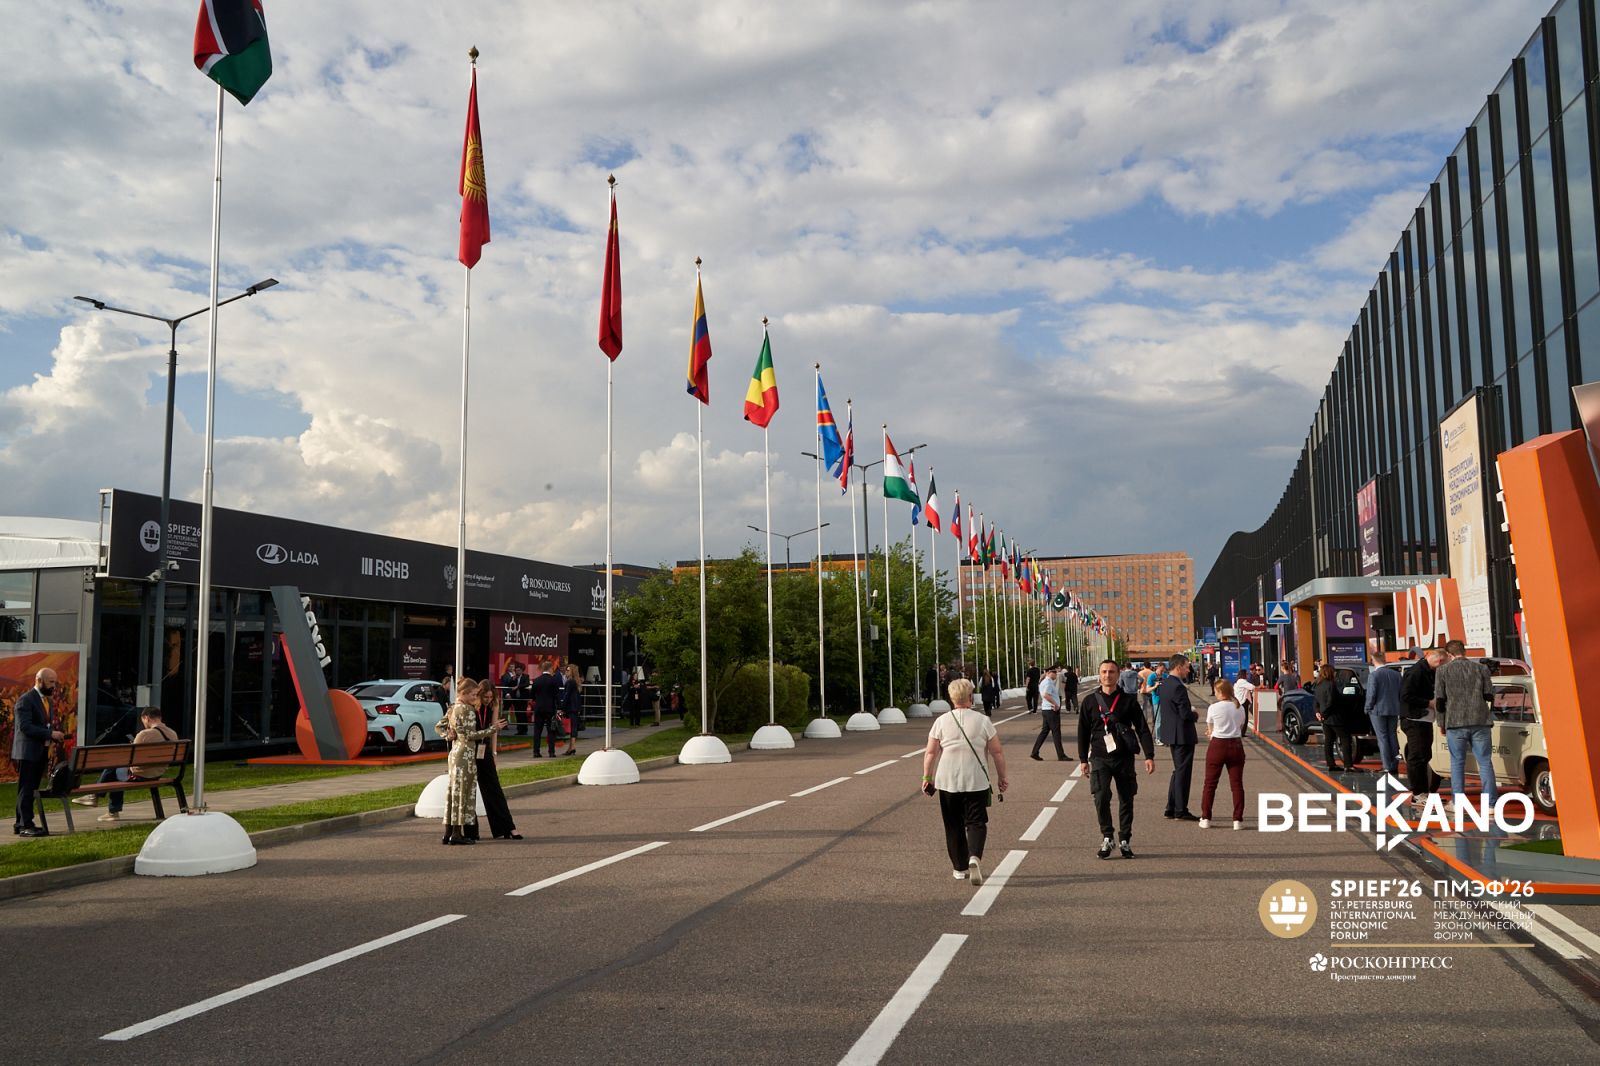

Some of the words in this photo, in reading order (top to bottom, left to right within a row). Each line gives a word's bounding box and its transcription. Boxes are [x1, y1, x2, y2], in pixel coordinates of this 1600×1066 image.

[167, 523, 201, 537] SPIEF'26
[290, 550, 319, 566] LADA
[375, 558, 410, 580] RSHB
[529, 578, 571, 592] ROSCONGRESS
[1336, 609, 1354, 630] G
[1393, 578, 1450, 650] LADA
[521, 632, 558, 648] VinoGrad
